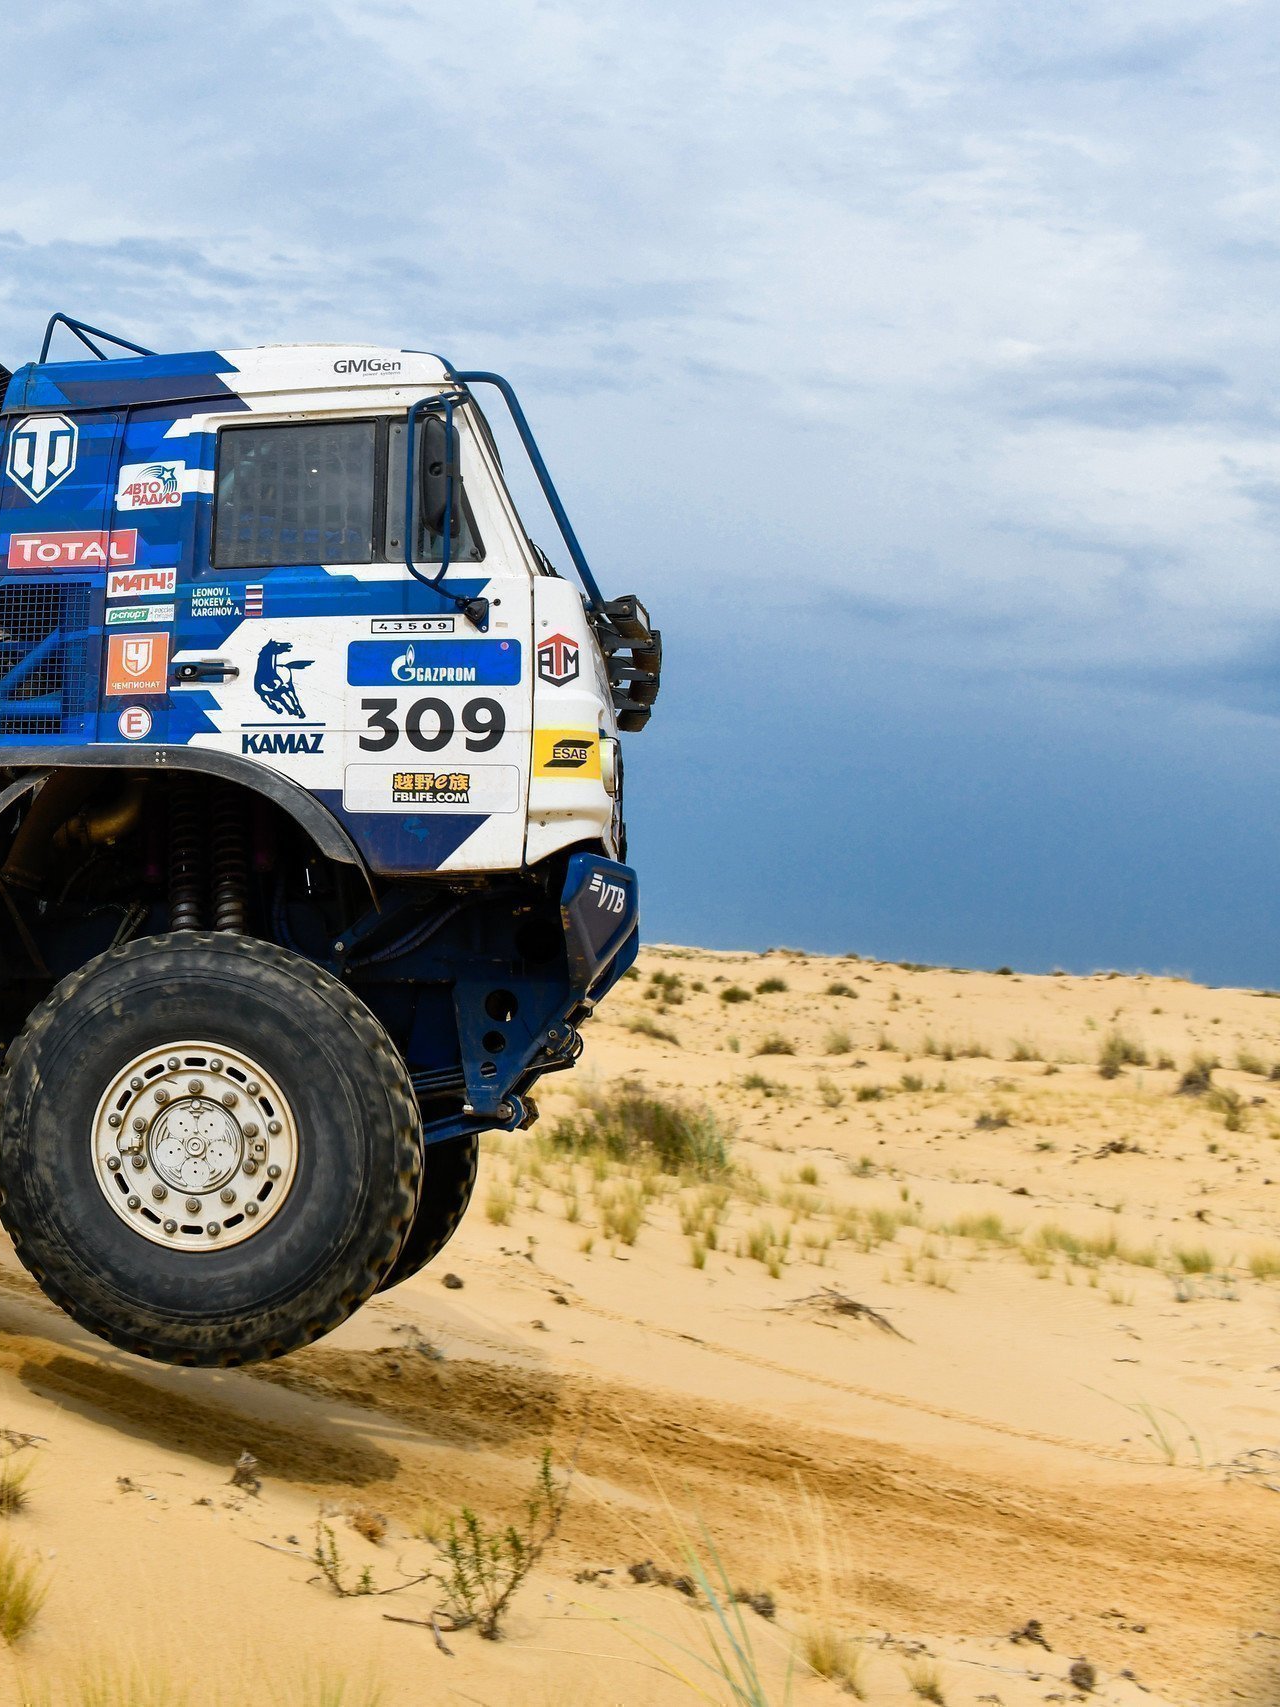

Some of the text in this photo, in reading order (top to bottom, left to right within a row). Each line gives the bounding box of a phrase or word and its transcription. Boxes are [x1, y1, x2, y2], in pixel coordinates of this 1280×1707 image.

[333, 359, 401, 373] GMGen
[122, 481, 160, 496] АВТО
[132, 491, 180, 506] РАДИО
[16, 539, 129, 562] TOTAL
[112, 572, 174, 592] МАТЧ!
[192, 587, 231, 597] LEONOV I.
[192, 597, 234, 607] MOKEEV A.
[191, 607, 242, 617] KARGINOV A.
[379, 622, 447, 630] 43509
[416, 667, 476, 682] GAZPROM
[112, 681, 161, 690] ЧЕМПИОНАТ
[127, 713, 142, 733] E
[359, 697, 506, 752] 309
[241, 733, 324, 754] KAMAZ
[553, 747, 587, 760] ESAB
[393, 773, 469, 791] 越野e族
[394, 792, 468, 802] FBLIFE.COM
[597, 881, 626, 915] VTB
